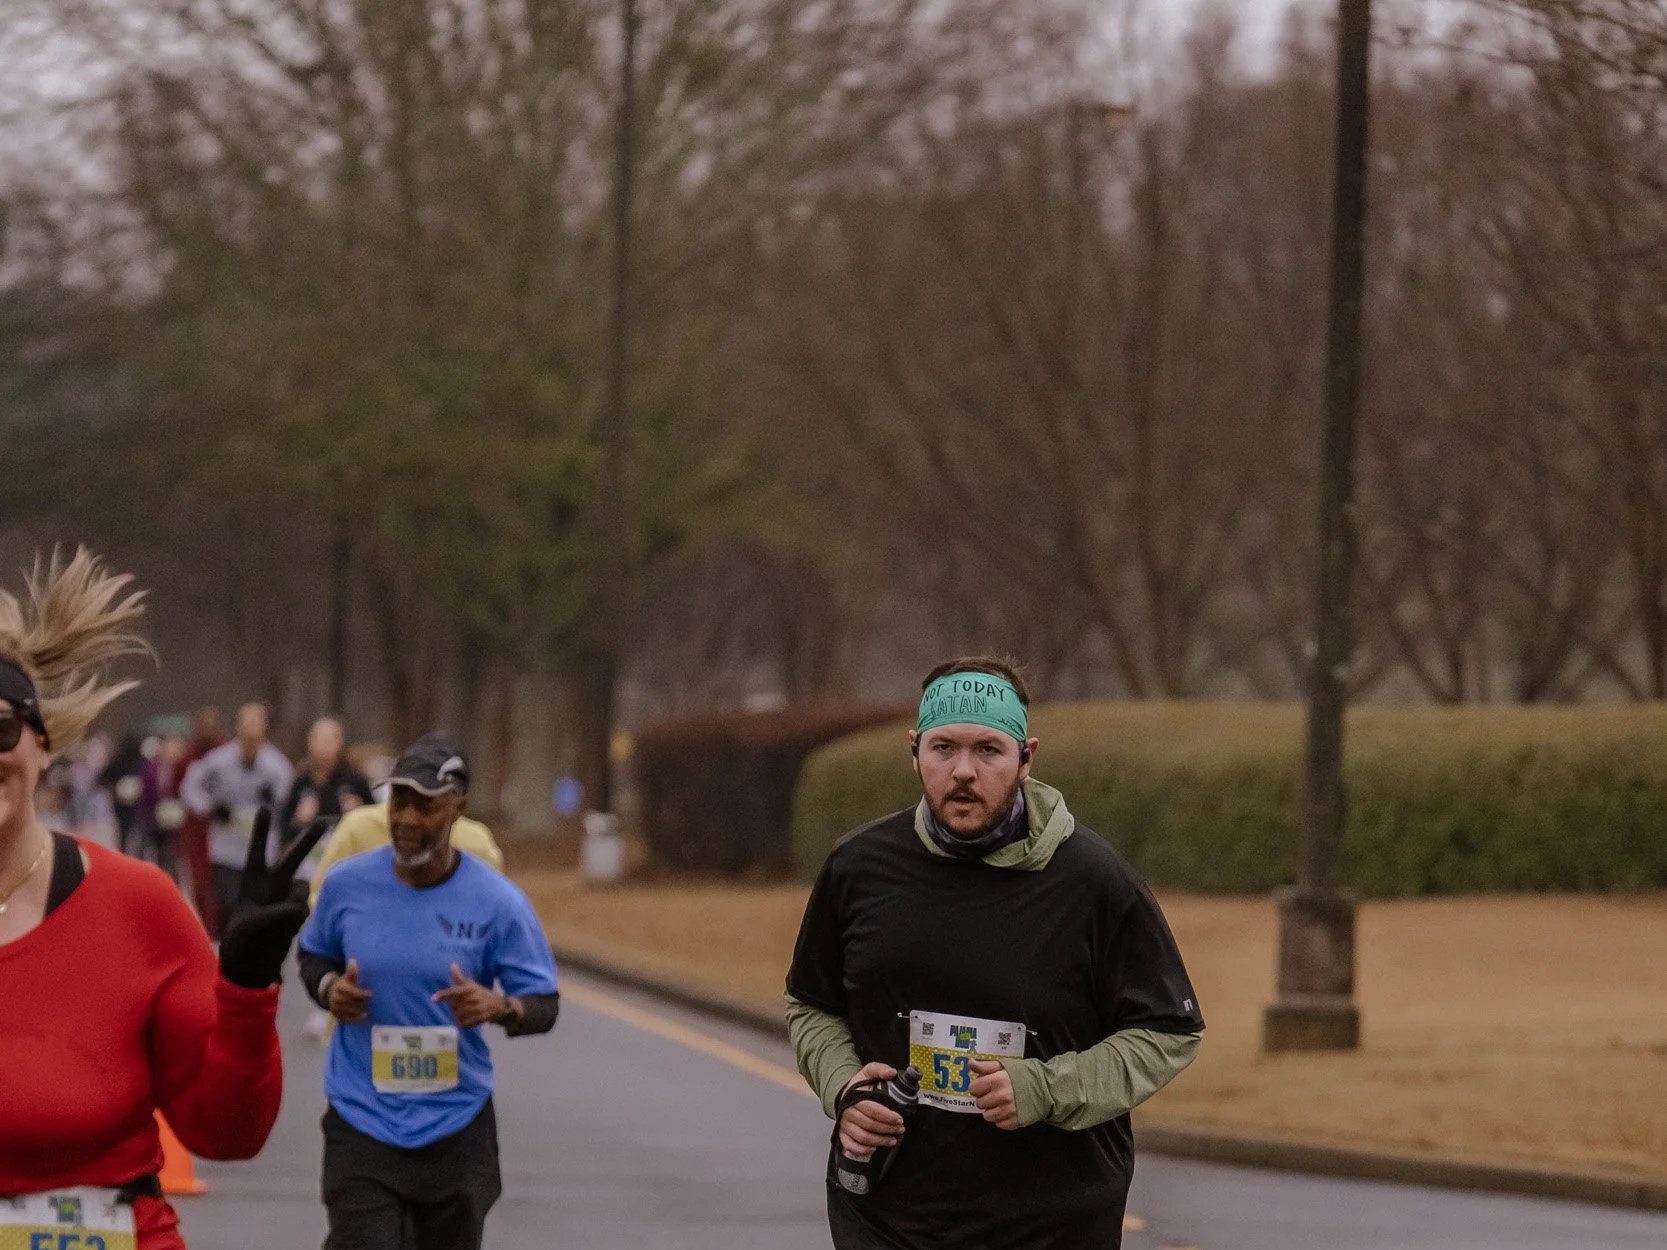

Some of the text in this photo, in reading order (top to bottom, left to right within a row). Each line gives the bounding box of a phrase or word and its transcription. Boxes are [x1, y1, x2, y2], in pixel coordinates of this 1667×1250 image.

[924, 680, 1004, 704] NOT TODAY
[931, 695, 987, 718] SATAN
[933, 1053, 971, 1093] 53
[924, 1092, 975, 1107] www.FiveStarN
